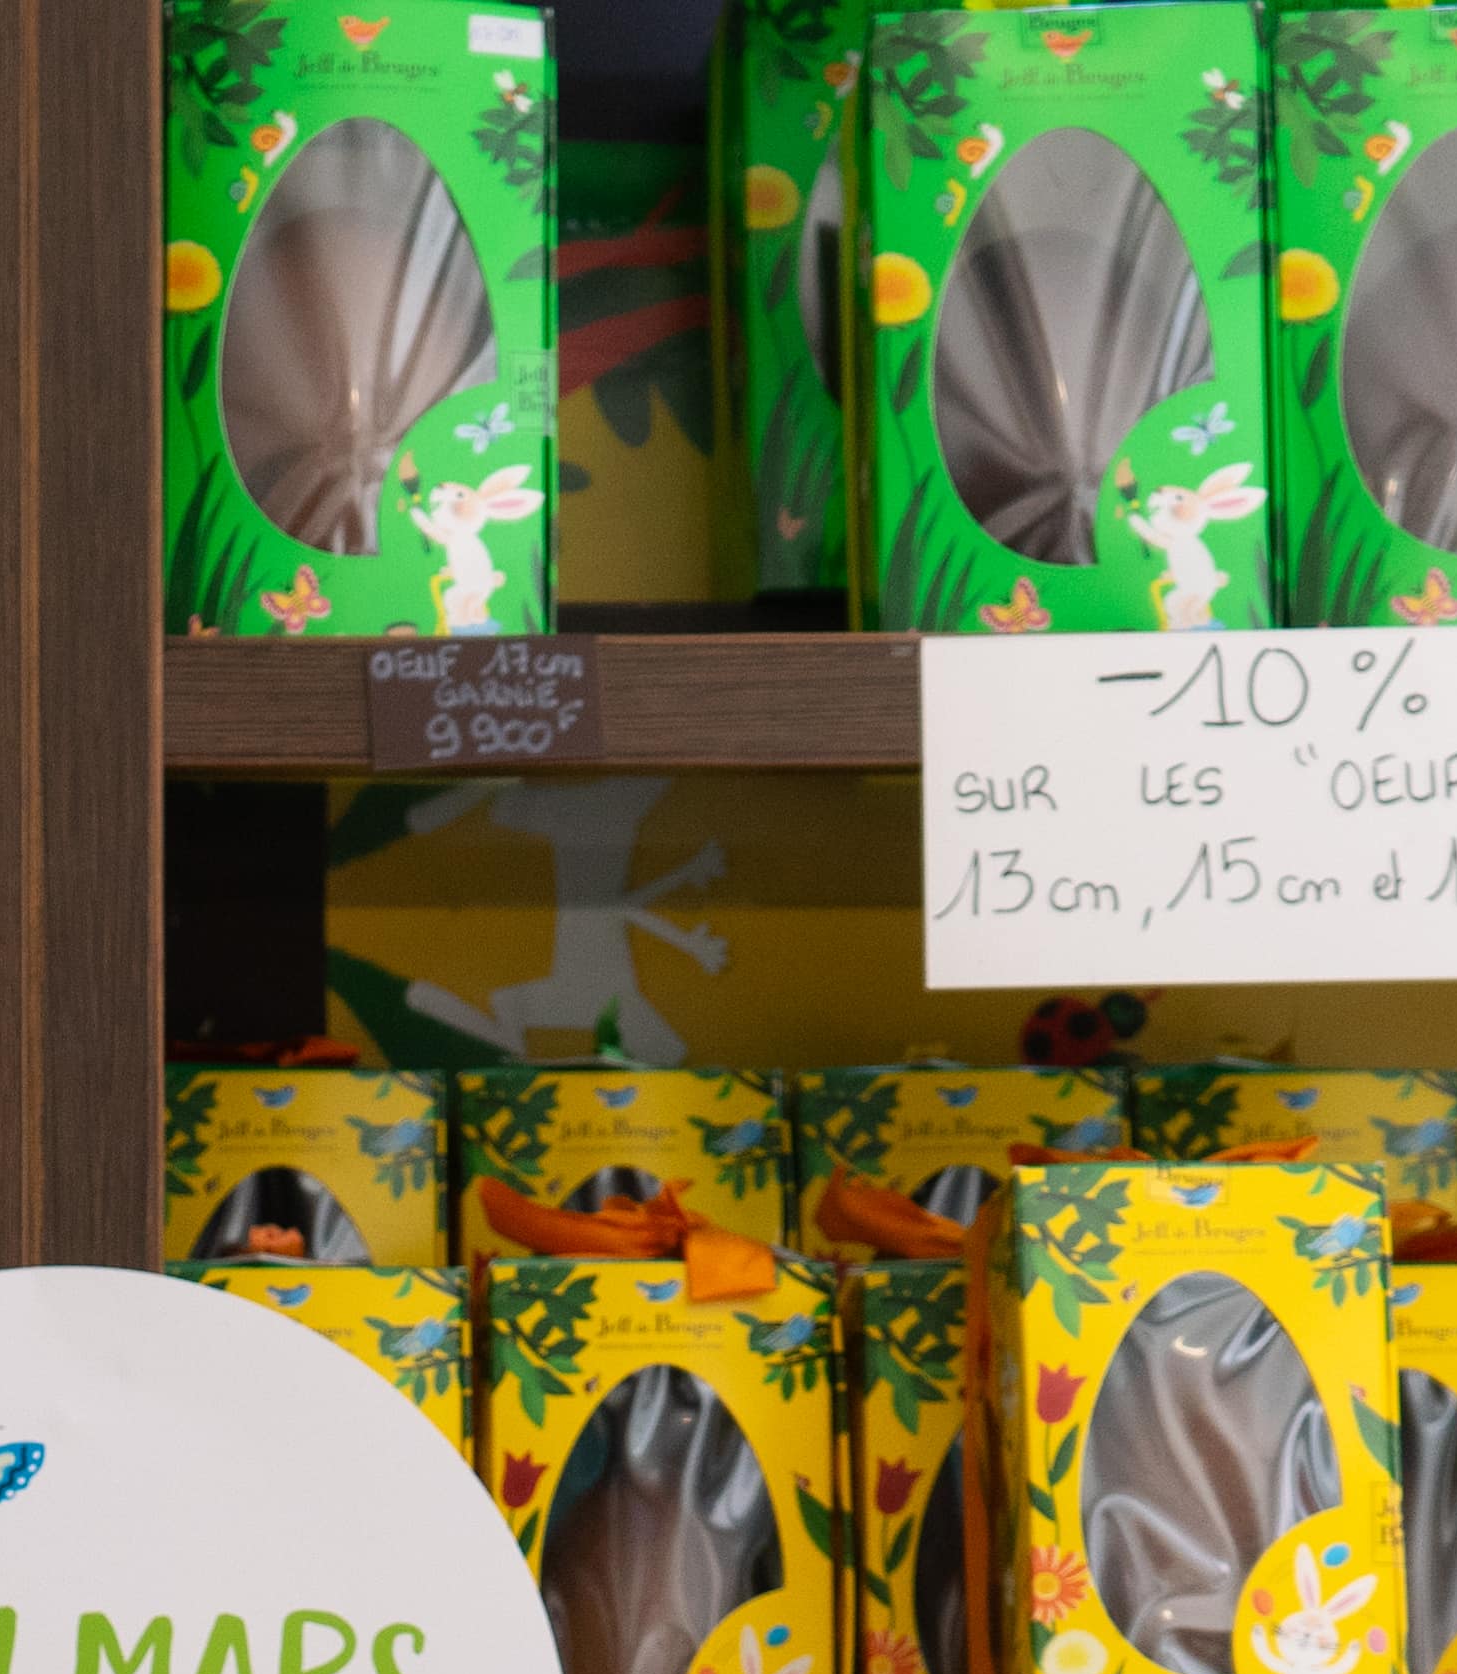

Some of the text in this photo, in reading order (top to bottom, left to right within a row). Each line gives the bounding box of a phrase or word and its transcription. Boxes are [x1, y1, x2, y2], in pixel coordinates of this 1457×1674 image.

[371, 643, 458, 682] OEUF
[953, 765, 1057, 814] SUR
[1139, 762, 1223, 806] LES
[1373, 851, 1405, 901] et
